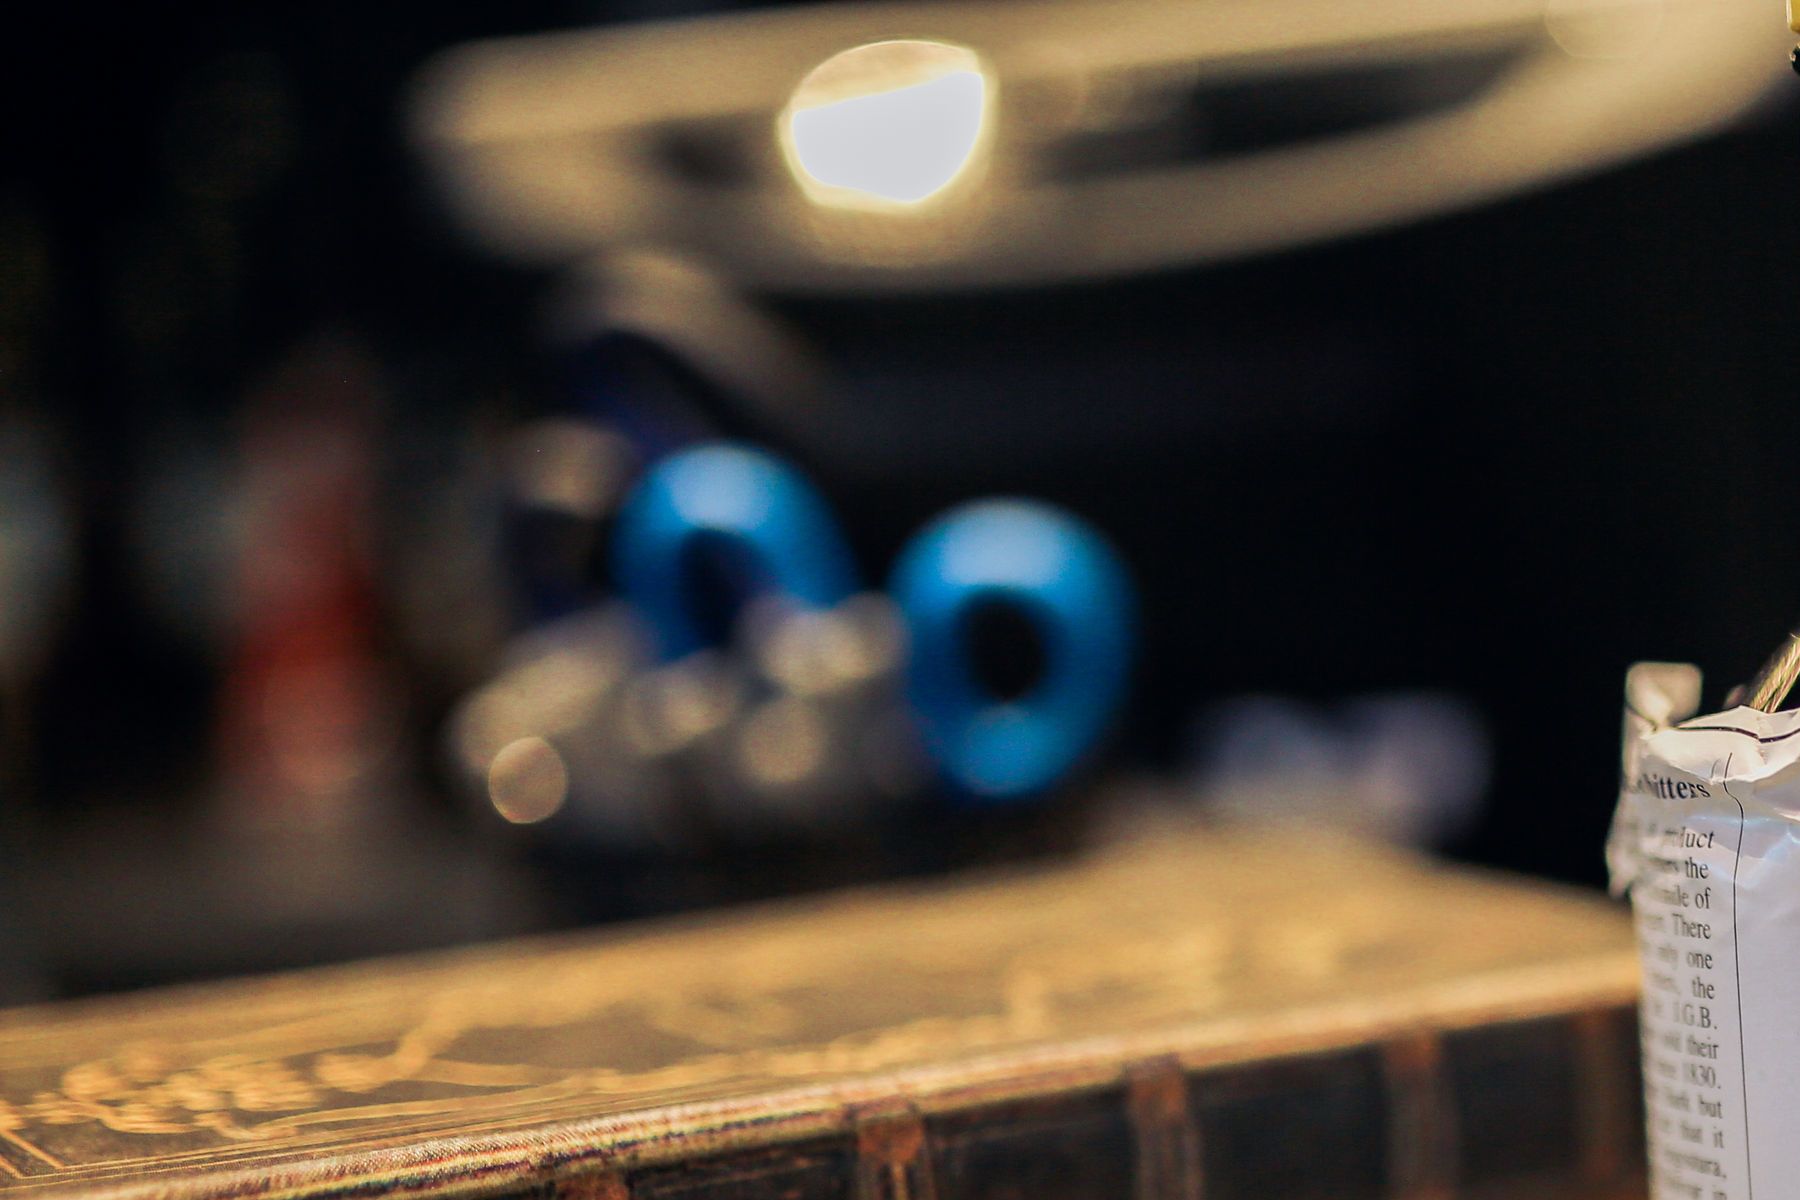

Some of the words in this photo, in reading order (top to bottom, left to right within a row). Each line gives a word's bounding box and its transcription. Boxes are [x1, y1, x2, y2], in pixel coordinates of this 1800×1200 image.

[1684, 856, 1709, 880] the
[1694, 886, 1711, 910] of
[1672, 912, 1711, 940] There
[1686, 951, 1713, 970] one
[1691, 975, 1716, 1000] the
